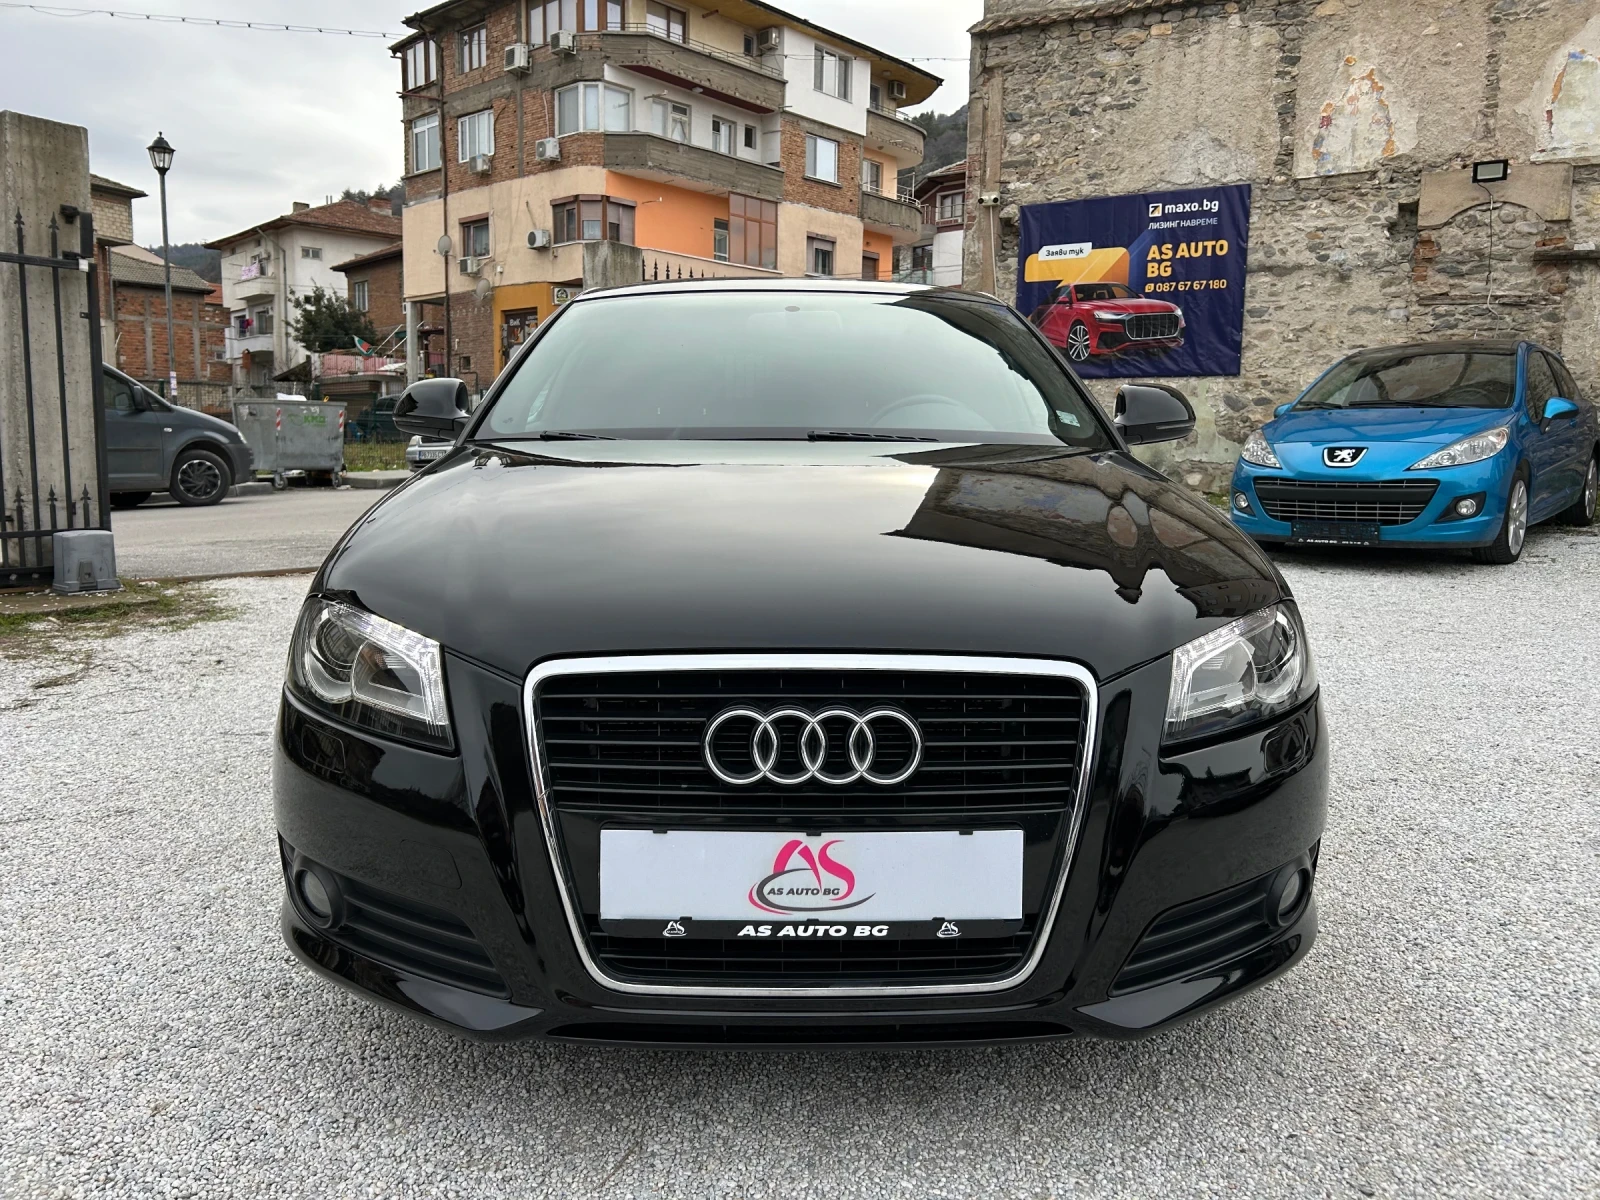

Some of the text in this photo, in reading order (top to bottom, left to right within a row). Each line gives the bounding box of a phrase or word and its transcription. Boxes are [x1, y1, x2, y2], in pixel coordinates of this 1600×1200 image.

[1164, 198, 1219, 214] maxo.bg
[1148, 217, 1218, 230] ЛИЗИНГ НАВРЕМЕ
[1045, 247, 1084, 257] Заяви тук
[1146, 239, 1229, 260] AS AUTO
[1146, 261, 1172, 278] BG
[1155, 279, 1227, 292] 087 67 67 180
[773, 839, 856, 901] AS
[767, 887, 840, 896] AS AUTO BG
[737, 925, 890, 937] AS AUTO BG
